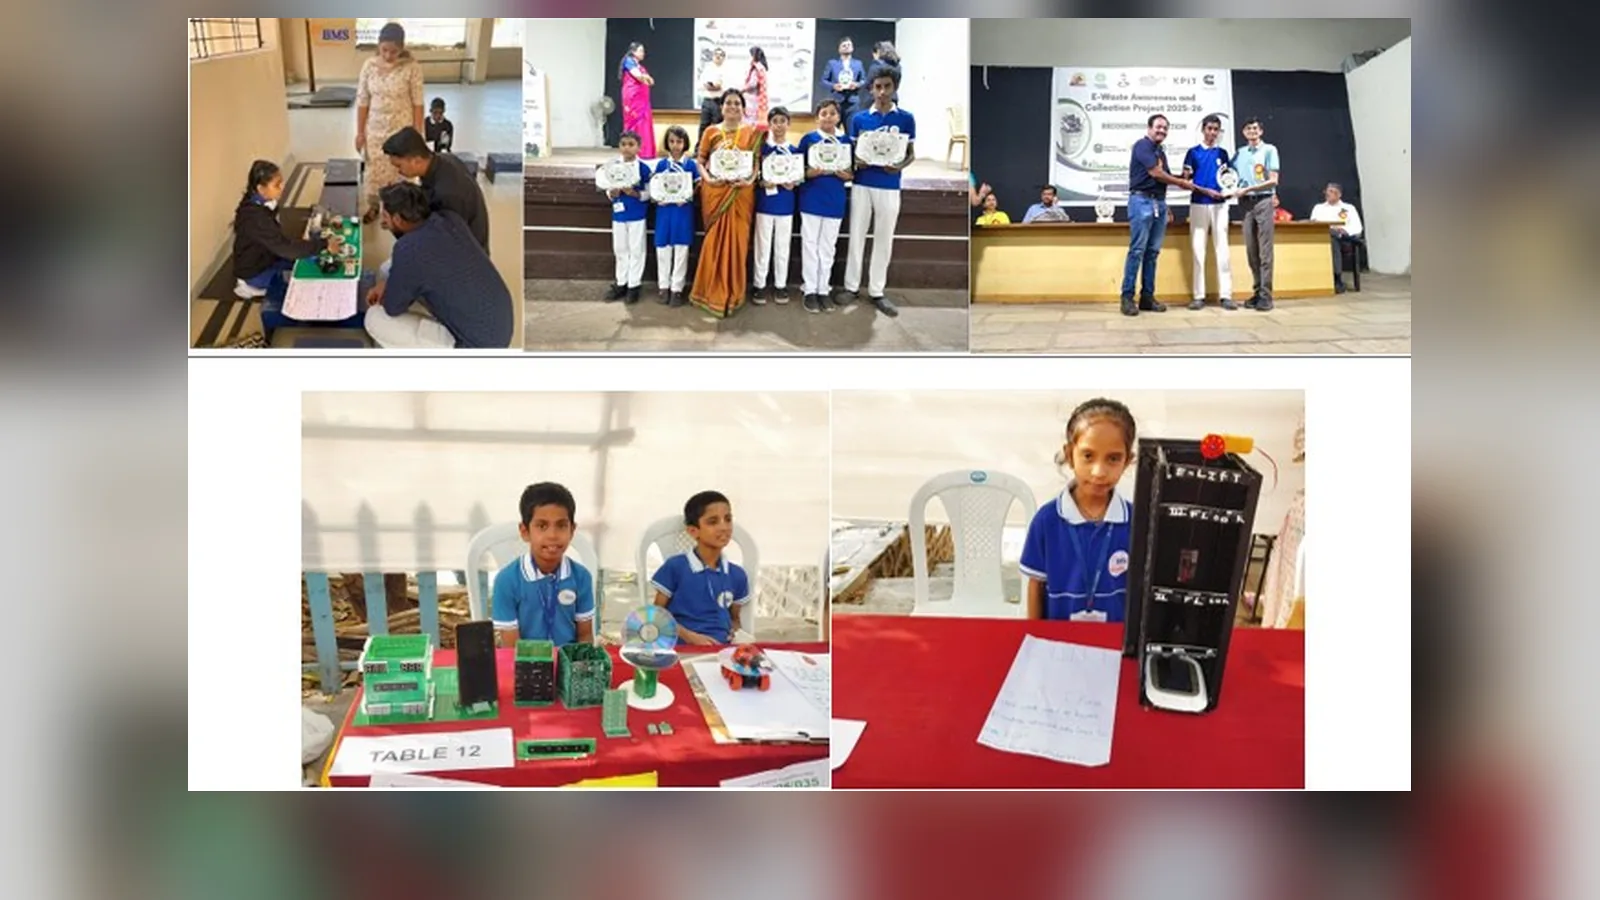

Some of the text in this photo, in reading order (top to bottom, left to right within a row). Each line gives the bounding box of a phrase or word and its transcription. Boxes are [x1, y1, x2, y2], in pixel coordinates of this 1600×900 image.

[1173, 76, 1196, 85] KPIT
[1091, 93, 1196, 102] E-Waste Awareness and
[1085, 103, 1203, 113] Collection Project 2025-26
[370, 744, 482, 762] TABLE 12
